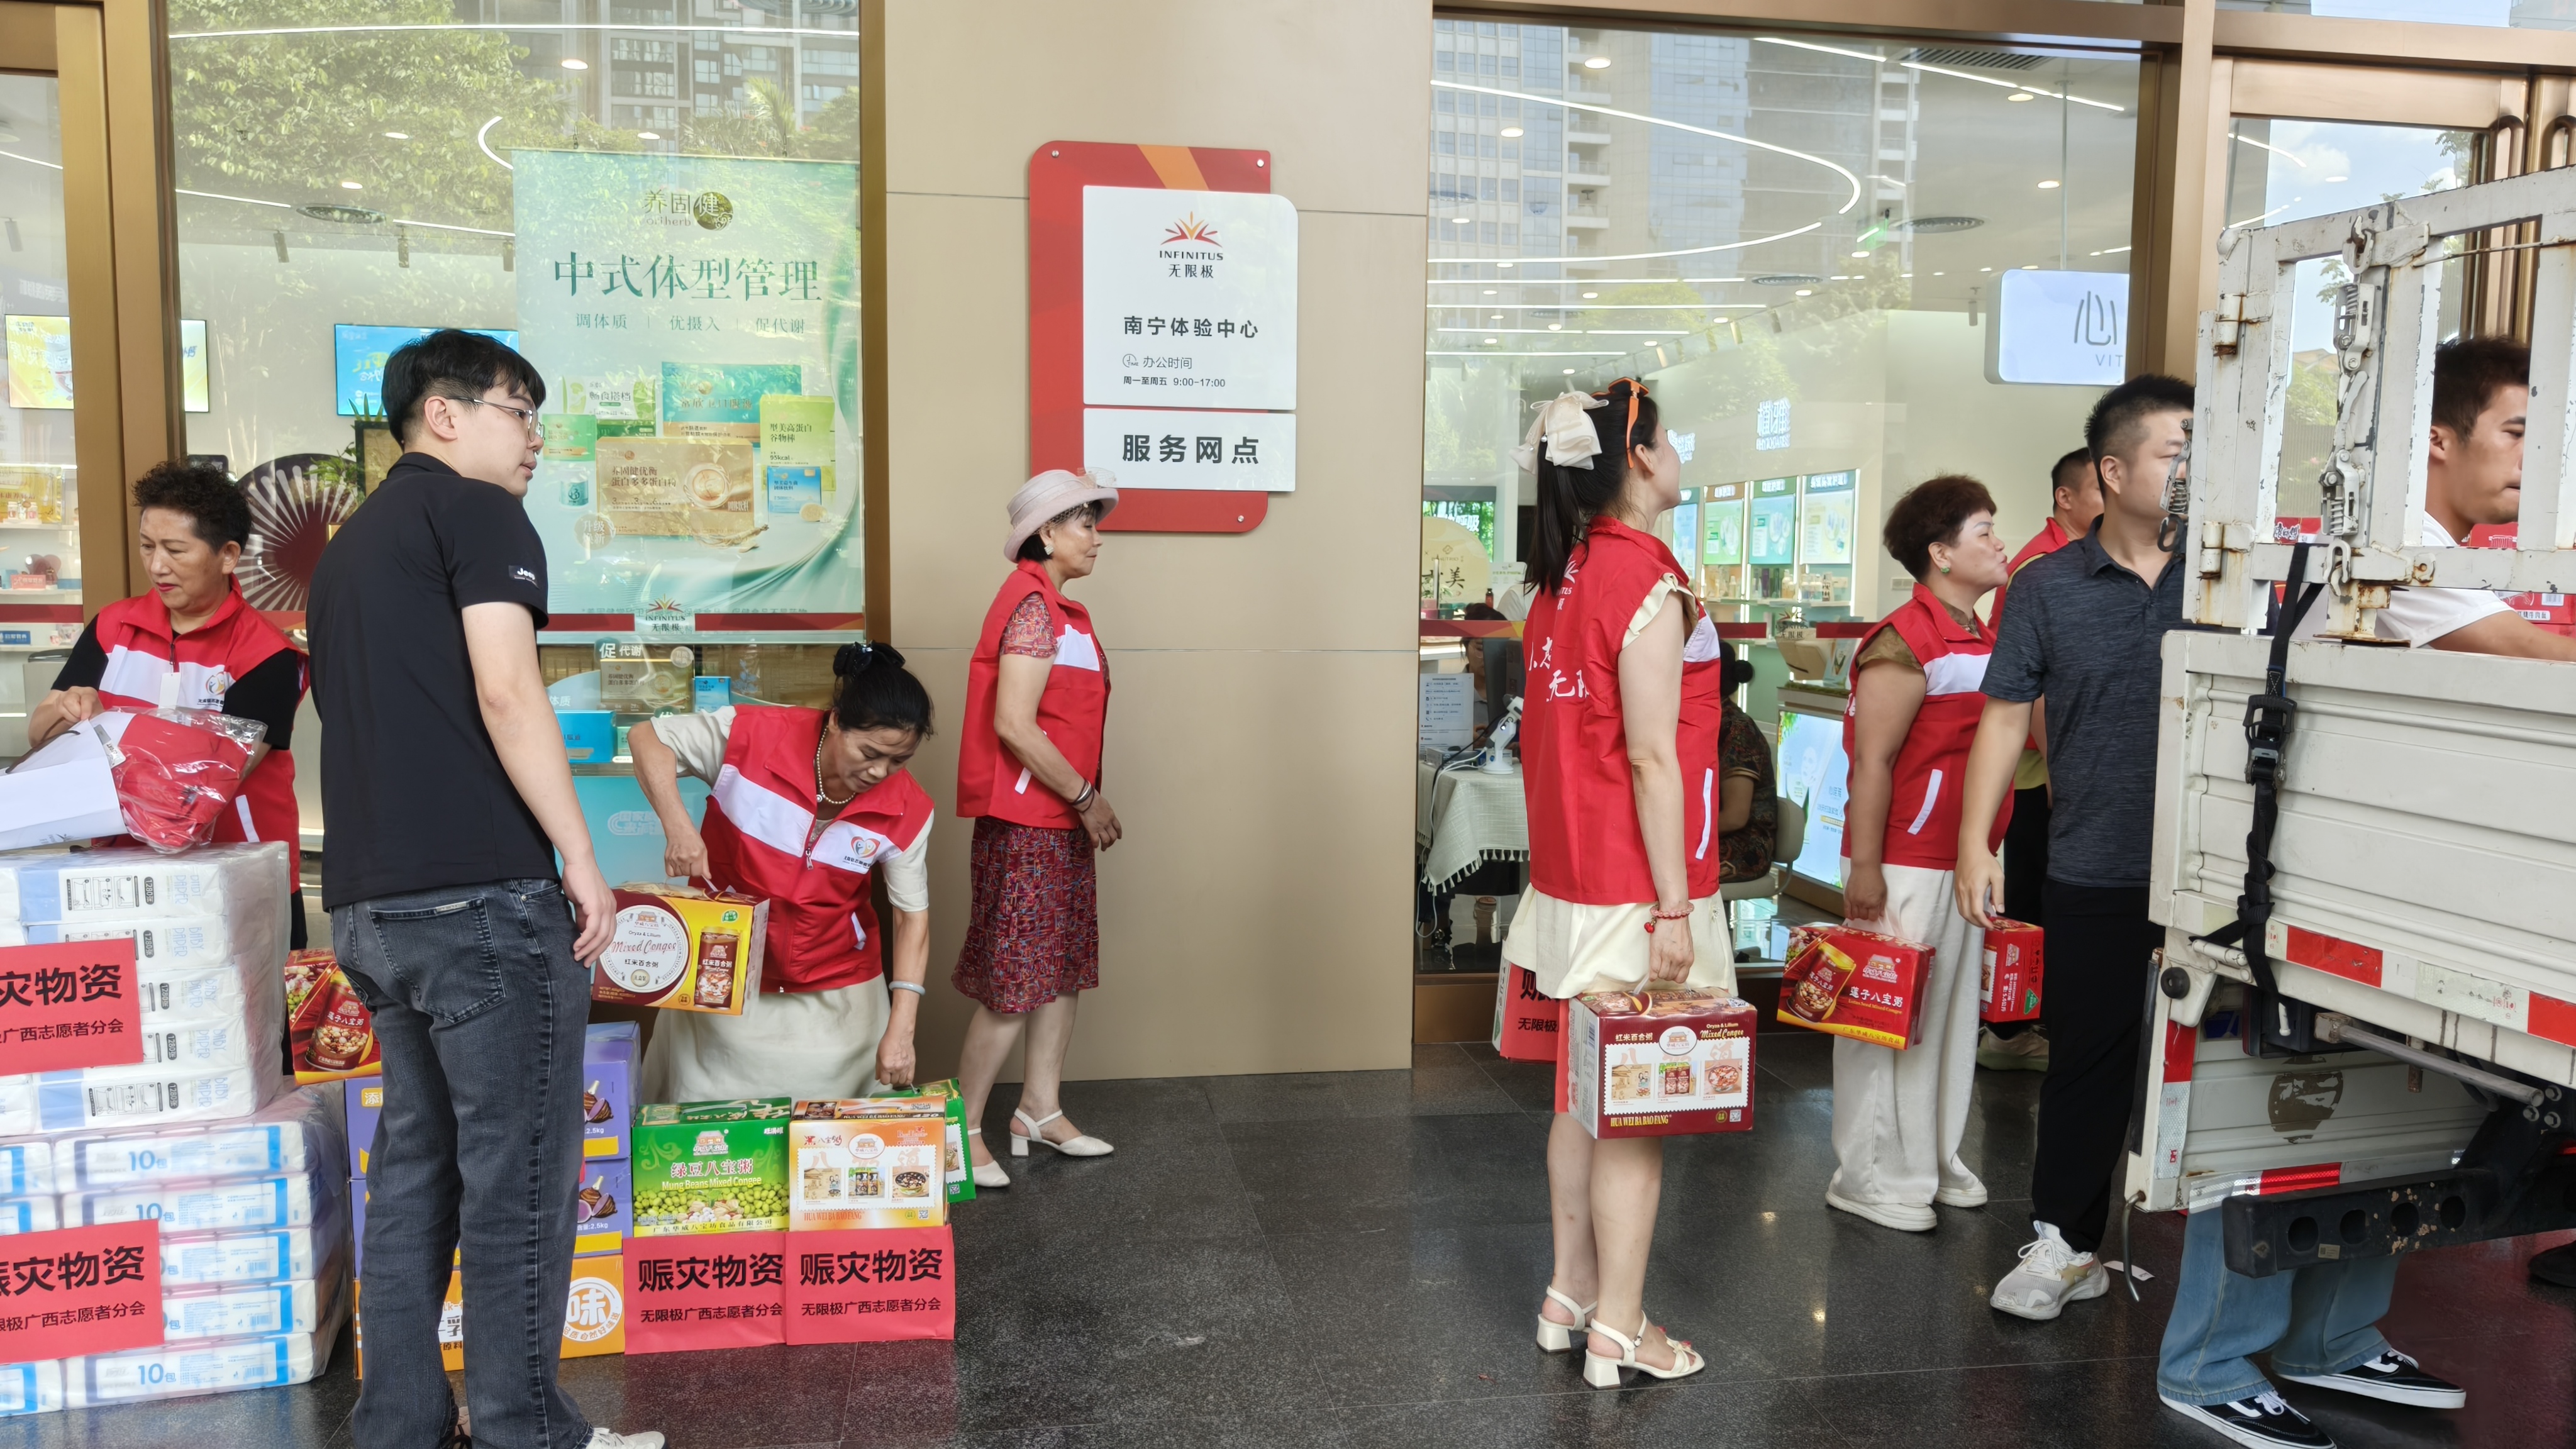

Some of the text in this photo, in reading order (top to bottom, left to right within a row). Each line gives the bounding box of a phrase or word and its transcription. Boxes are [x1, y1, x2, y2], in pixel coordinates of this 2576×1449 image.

[1159, 250, 1224, 261] INFINITUS
[554, 252, 822, 301] 中式体型管理
[1169, 264, 1214, 279] 无限极
[576, 313, 806, 334] 调体质 优摄入 促代谢
[1123, 316, 1259, 339] 南宁体验中心
[1143, 355, 1192, 370] 办公时间
[1124, 376, 1226, 387] 周一至周五 9:00-17:00
[770, 423, 813, 433] 型美高蛋白
[1123, 435, 1260, 465] 服务网点
[652, 623, 680, 632] 无限极
[611, 941, 641, 953] Mixed
[625, 959, 658, 968] 红米百合粥
[1849, 986, 1904, 1008] 莲子八宝粥
[0, 1018, 123, 1044] 广西志愿者分会
[1518, 1018, 1559, 1033] 无限极
[1615, 1033, 1653, 1041] 红米百合粥
[1700, 1029, 1722, 1039] Mixed
[1611, 1116, 1669, 1127] HUA WEI BA BAO FANG
[128, 1150, 167, 1172] 10包
[670, 1159, 753, 1178] 绿豆八宝粥
[662, 1177, 762, 1193] Mung Beans Mixed Congee
[804, 1211, 862, 1222] HUA WEI BA BAO FANG
[639, 1253, 783, 1292] 赈灾物资
[800, 1248, 942, 1287] 赈灾物资
[640, 1302, 783, 1323] 无限极广西志愿者分会
[802, 1297, 941, 1316] 无限极广西志愿者分会
[138, 1363, 177, 1385] 10包
